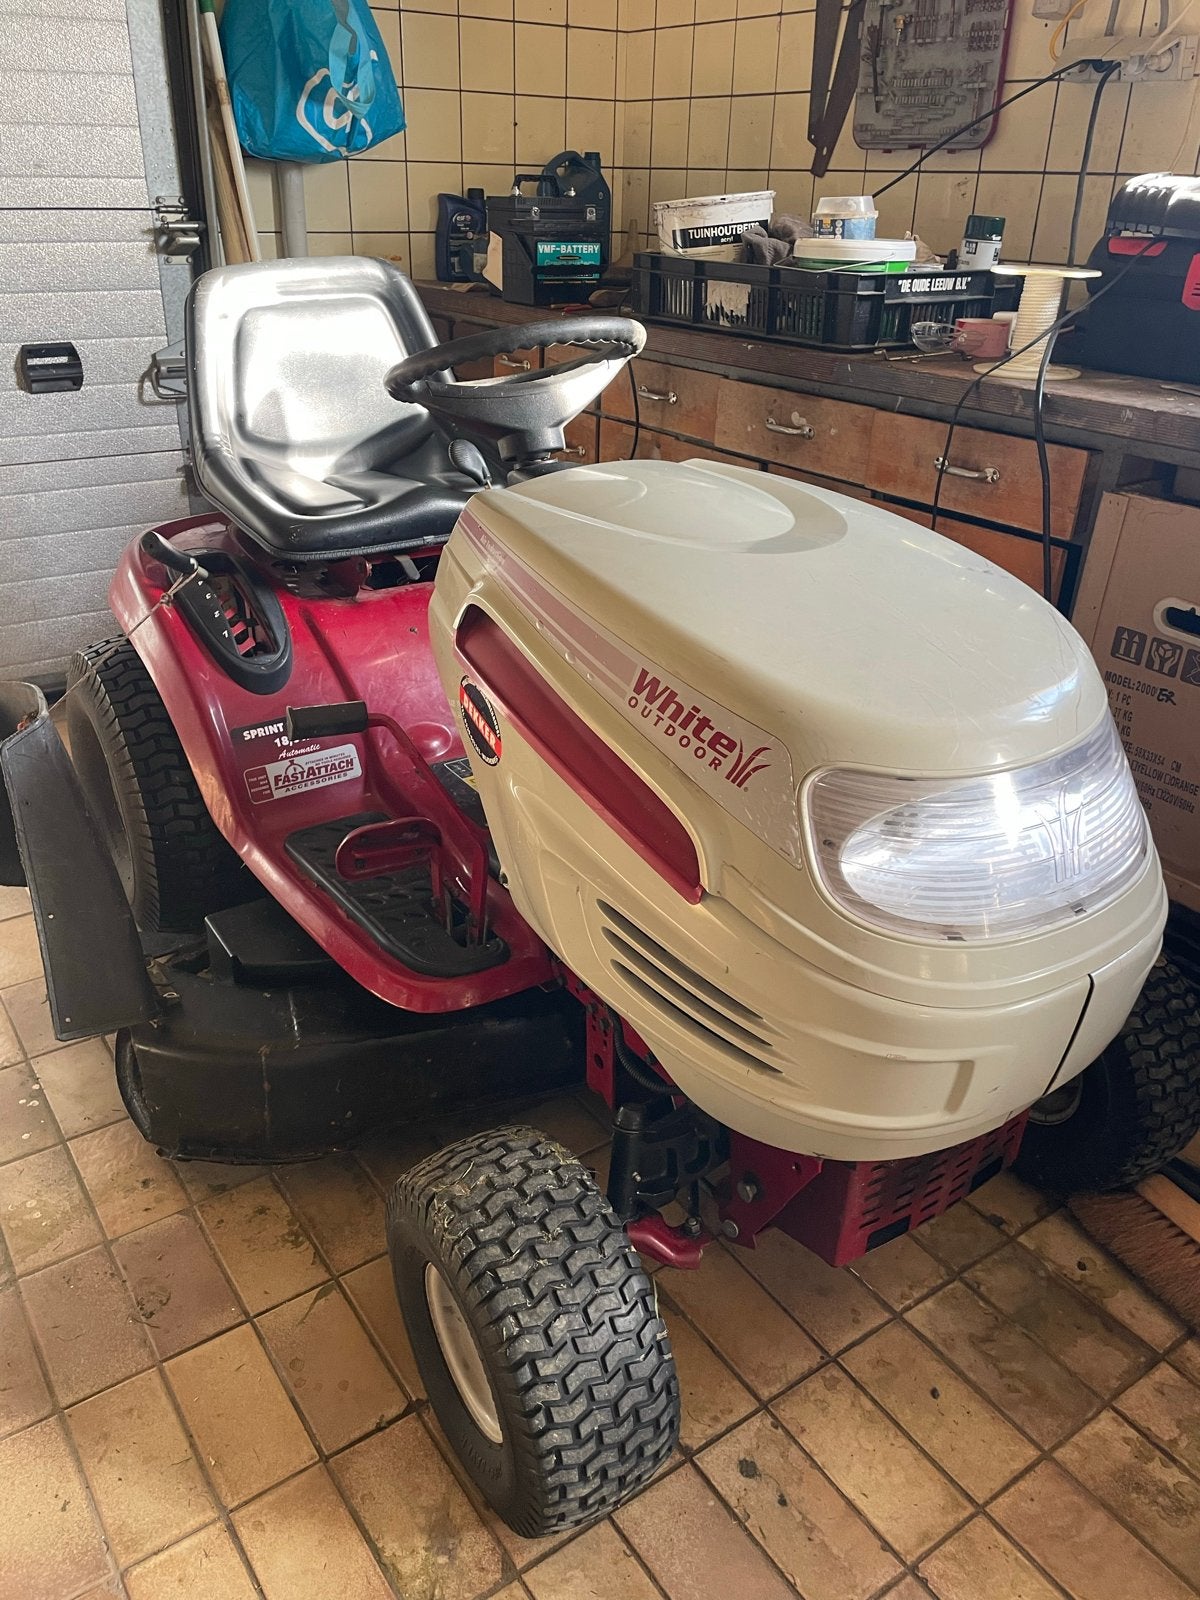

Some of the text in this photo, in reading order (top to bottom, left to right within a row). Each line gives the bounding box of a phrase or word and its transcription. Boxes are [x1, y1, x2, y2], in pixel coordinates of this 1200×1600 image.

[538, 244, 599, 254] VMF-BATTERY
[898, 279, 911, 293] "DE
[911, 278, 931, 292] OUDE
[930, 277, 955, 291] LEEUW
[1121, 693, 1132, 706] PC
[632, 667, 738, 759] White
[1122, 709, 1133, 722] KG
[463, 692, 496, 752] DEKKER
[243, 722, 284, 741] SPRINT
[628, 696, 723, 772] OUTDOOR
[1120, 725, 1131, 738] KG
[278, 743, 320, 760] Automatic
[274, 758, 354, 786] FASTATTACH
[1170, 760, 1182, 773] CM
[284, 772, 348, 793] ACCESSORIES
